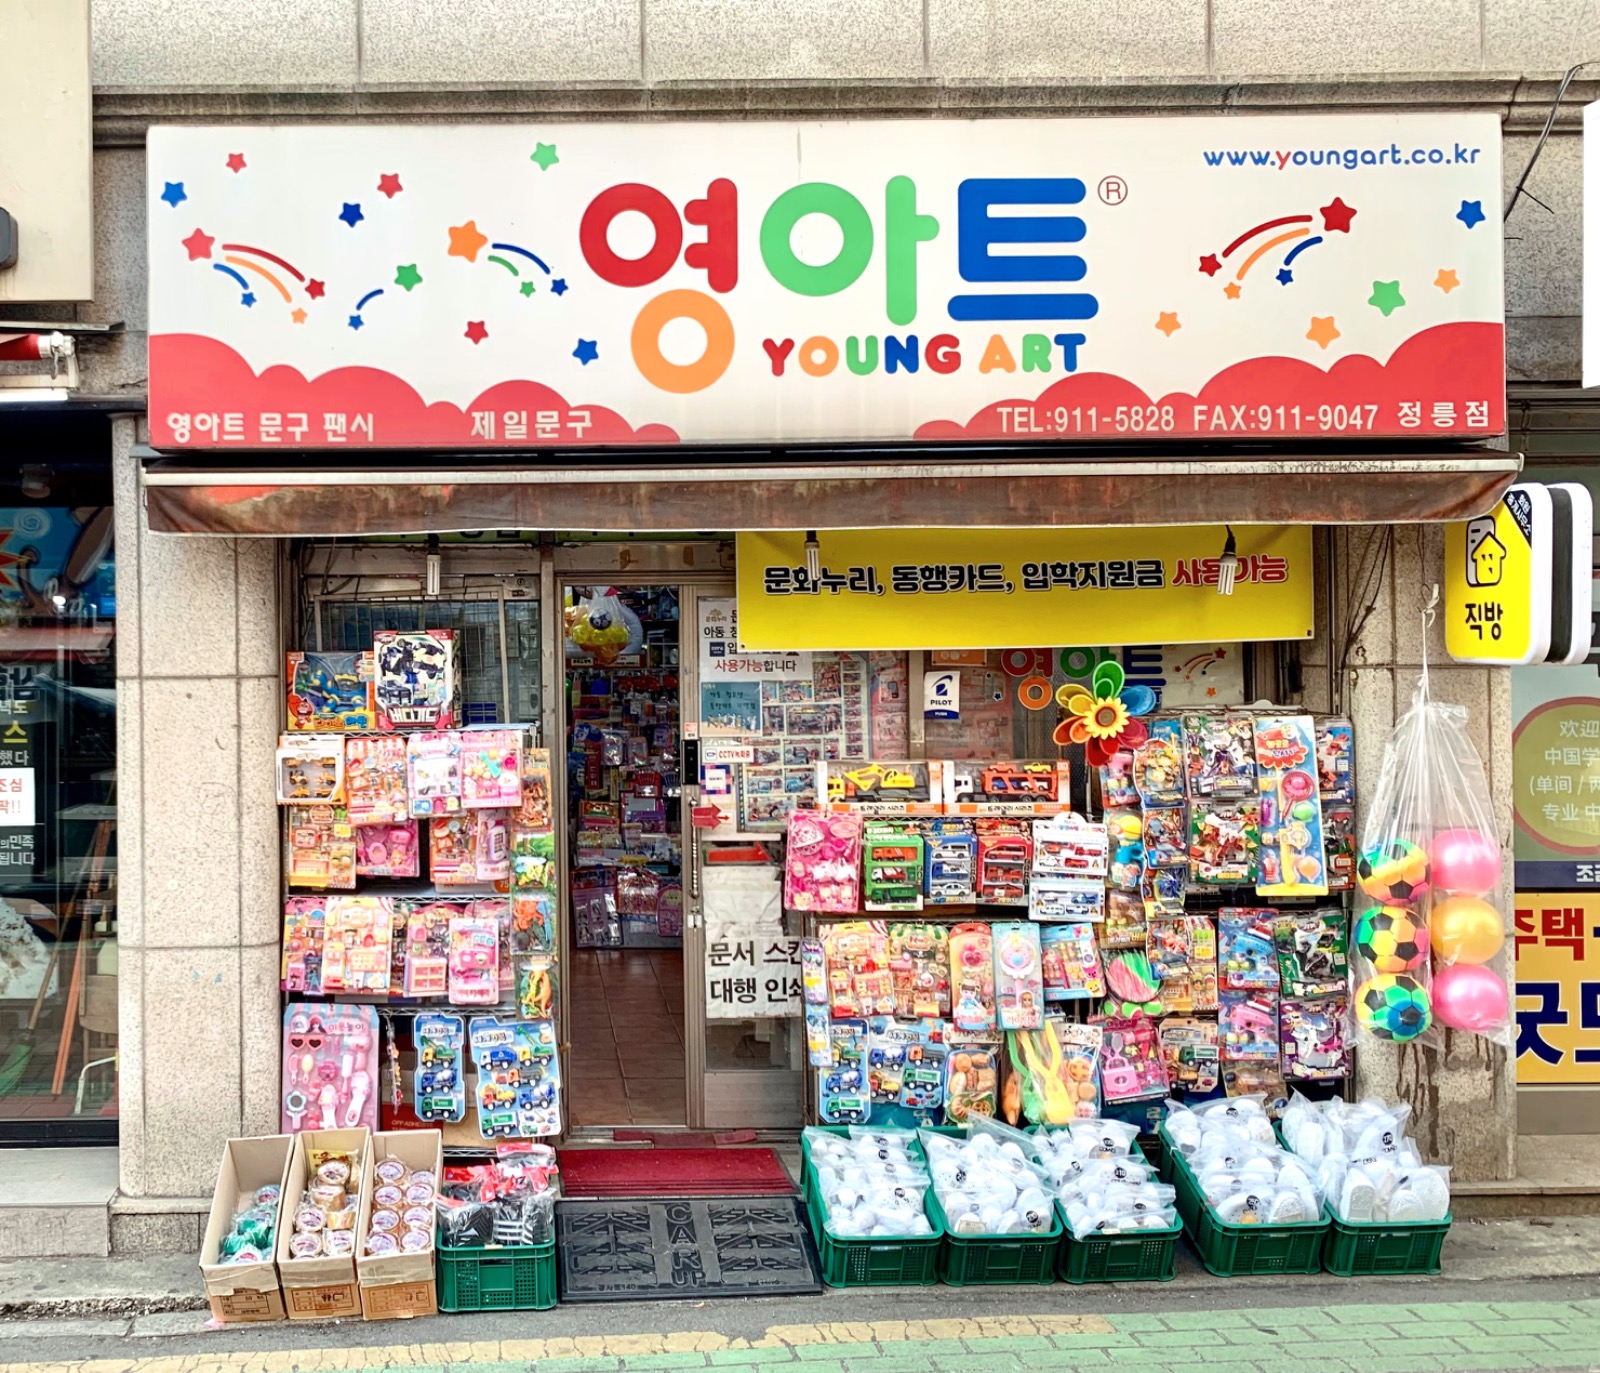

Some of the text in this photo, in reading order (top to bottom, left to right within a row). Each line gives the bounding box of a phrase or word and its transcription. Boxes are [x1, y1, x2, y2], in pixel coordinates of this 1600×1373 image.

[1204, 144, 1481, 170] www.youngart.co.kr
[579, 176, 1099, 393] 영아트
[763, 334, 1087, 376] YOUNG ART
[167, 411, 374, 444] 영아트 문구 팬시
[471, 409, 594, 440] 제일문구
[997, 404, 1378, 433] TEL:911-5828 FAX:911-9047
[1397, 400, 1490, 428] 정릉점
[763, 554, 1289, 595] 문화누리, 동행카드, 입학지원금 사용가능
[703, 626, 726, 639] 아동
[1464, 601, 1503, 640] 직방
[714, 659, 797, 673] 사용가능합니다
[1559, 719, 1600, 739] 欢迎
[1544, 747, 1600, 767] 中国学
[1541, 802, 1580, 822] 专业
[708, 940, 755, 967] 문서
[710, 977, 757, 1004] 대행
[671, 1270, 707, 1287] UP
